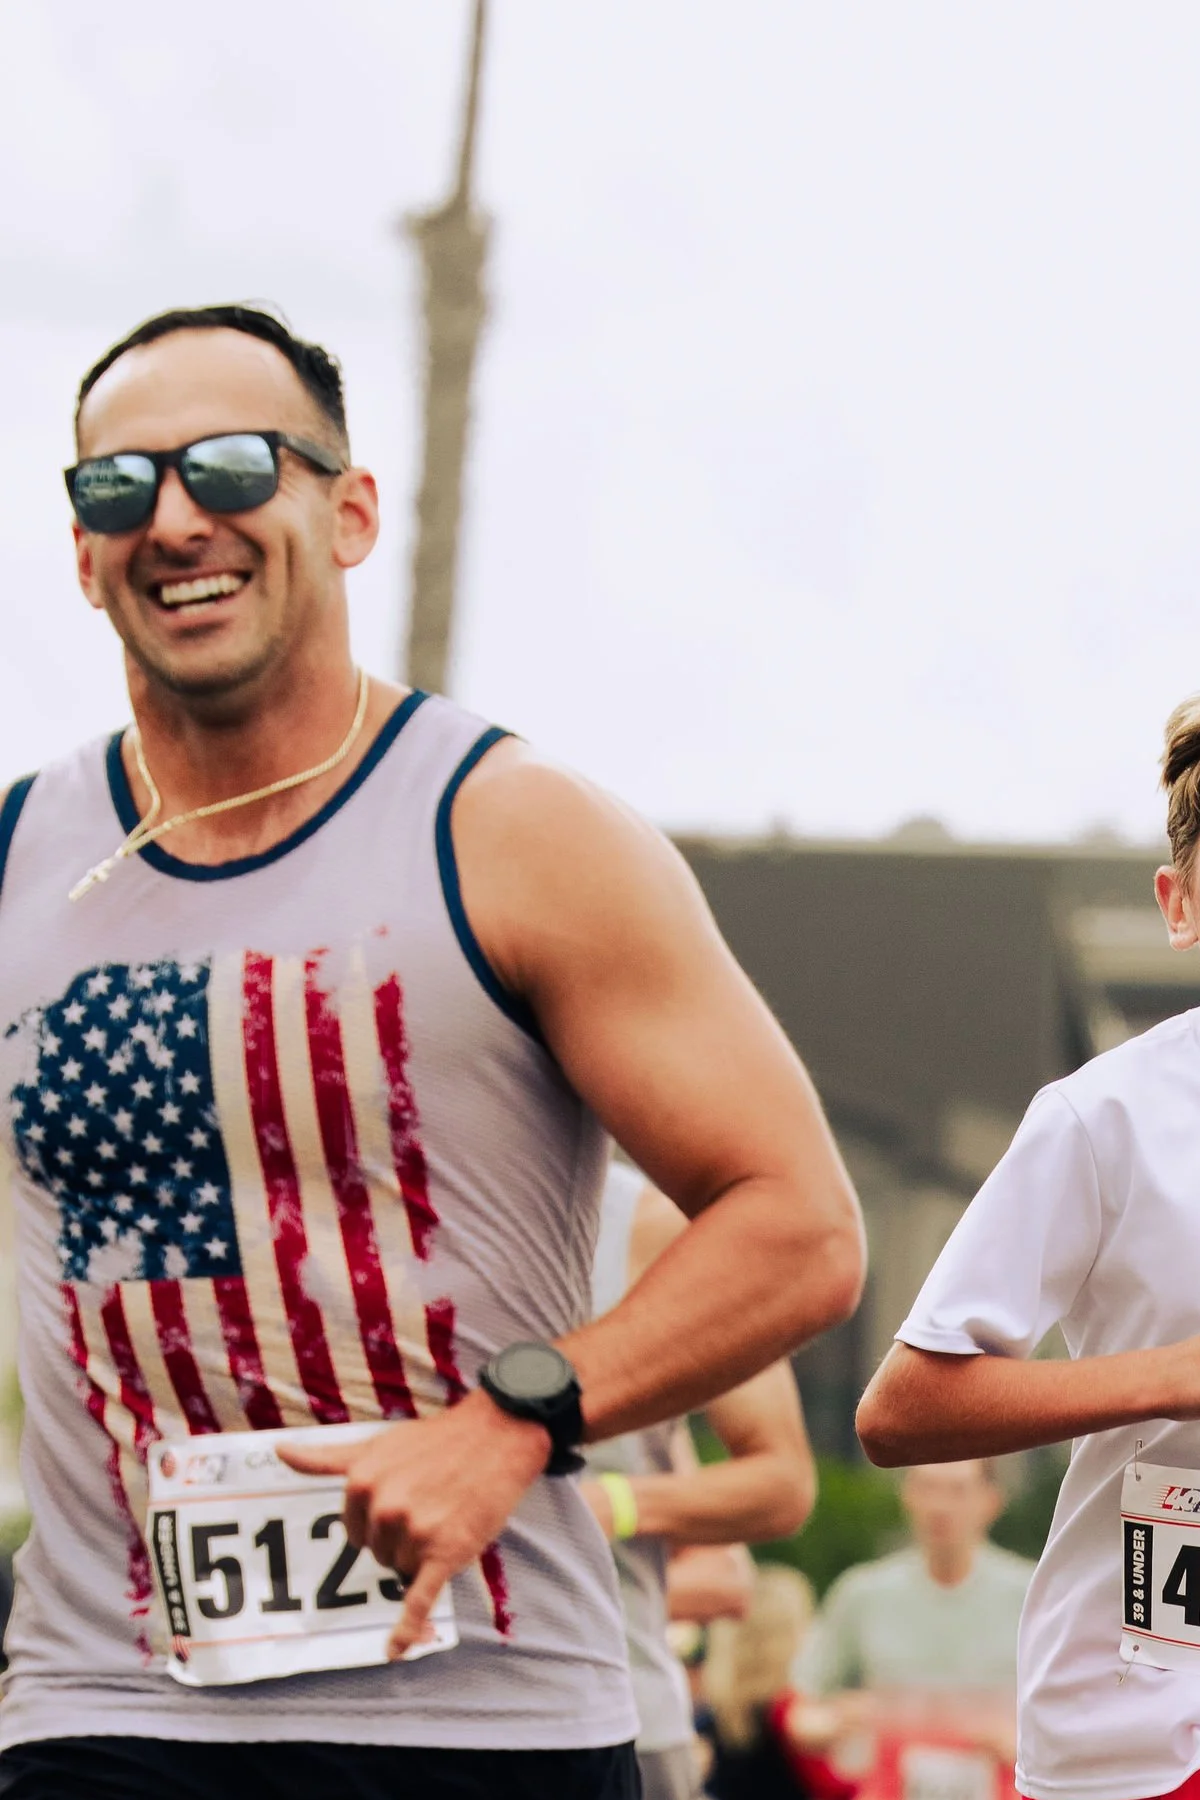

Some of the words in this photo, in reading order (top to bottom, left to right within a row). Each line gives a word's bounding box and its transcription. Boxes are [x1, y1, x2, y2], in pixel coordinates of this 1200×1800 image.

[1133, 1529, 1146, 1586] UNDER
[1133, 1589, 1145, 1600] &
[1133, 1603, 1145, 1623] 39
